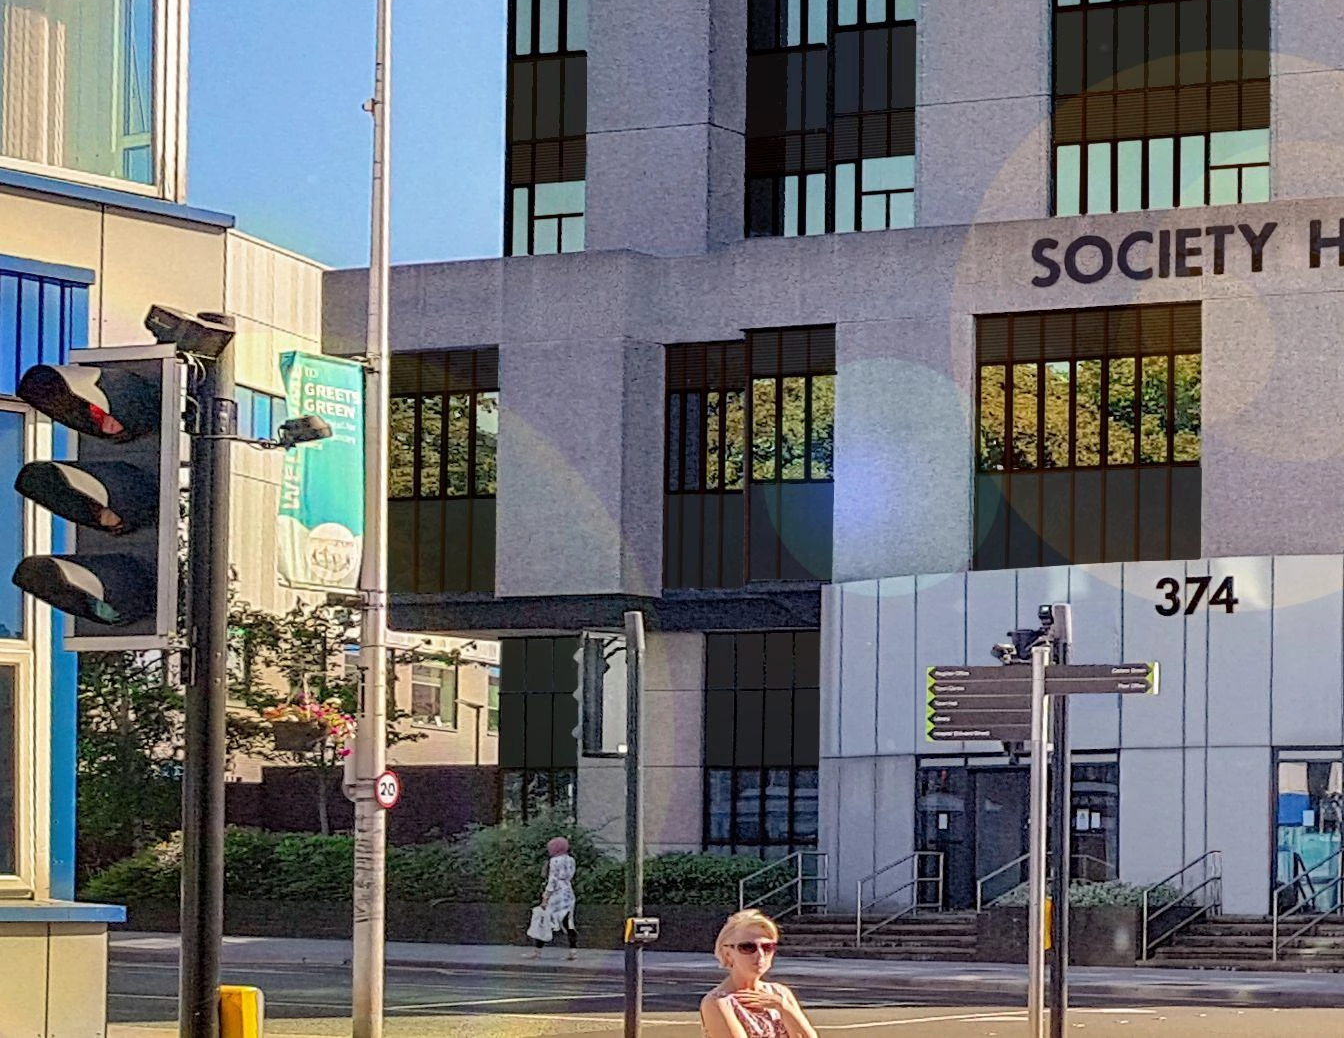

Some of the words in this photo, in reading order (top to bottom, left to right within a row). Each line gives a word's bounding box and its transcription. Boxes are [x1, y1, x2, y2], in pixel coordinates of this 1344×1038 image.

[1031, 221, 1278, 287] SOCIETY
[304, 382, 362, 406] GREETS
[303, 398, 356, 420] GREEN
[1155, 576, 1239, 616] 374
[380, 782, 395, 796] 20
